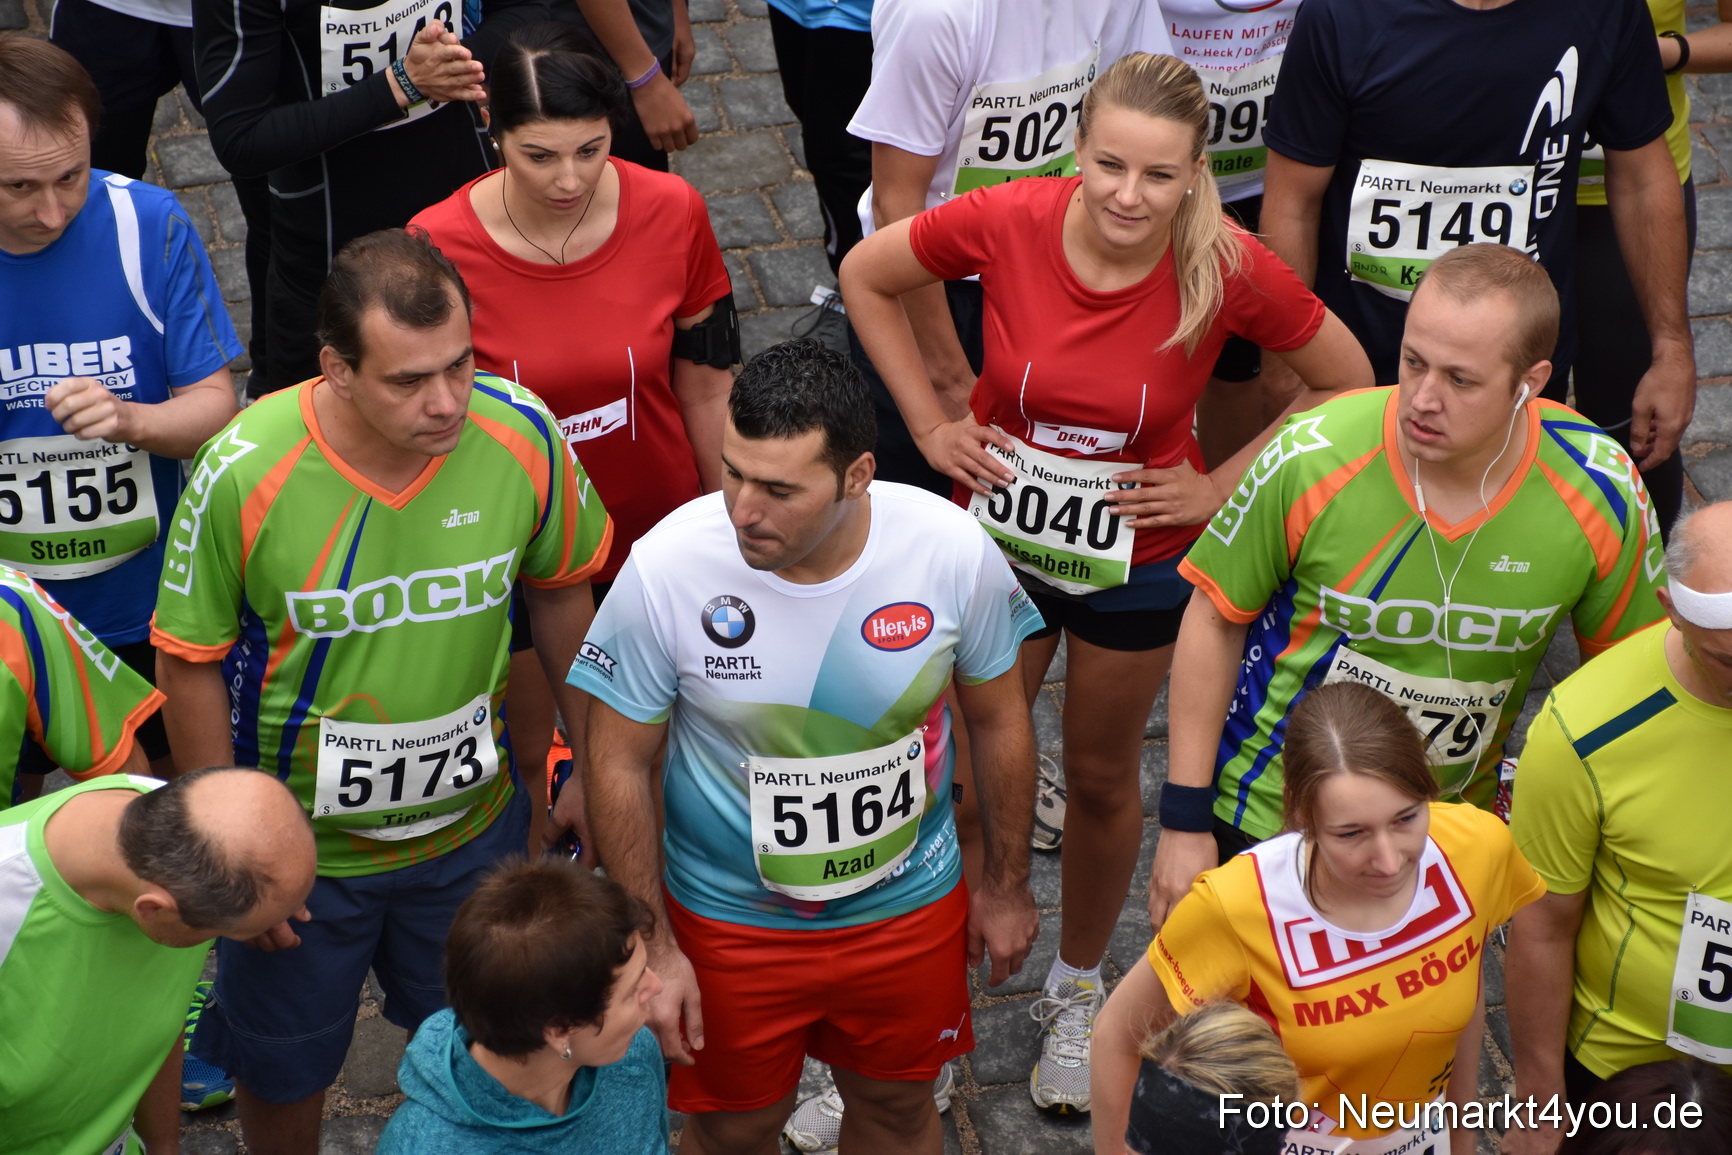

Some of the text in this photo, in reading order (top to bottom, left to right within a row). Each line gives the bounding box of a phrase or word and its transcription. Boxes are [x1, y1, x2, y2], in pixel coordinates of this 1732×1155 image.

[326, 22, 382, 35] PARTL
[1172, 23, 1233, 41] LAUFEN
[1241, 26, 1270, 40] MIT
[1184, 46, 1200, 56] Dr.
[1203, 48, 1233, 57] Heck
[972, 75, 1085, 109] PARTL Neumarkt
[1209, 74, 1276, 97] Neumarkt
[1361, 174, 1502, 194] PARTL Neumarkt
[1368, 199, 1513, 251] 5149
[0, 335, 133, 382] UBER
[6, 398, 45, 411] WASTE
[561, 416, 612, 438] DEHN
[1056, 431, 1099, 448] DEHN
[32, 444, 119, 464] Neumarkt
[1031, 464, 1112, 490] Neumarkt
[0, 461, 138, 526] 5155
[987, 477, 1121, 551] 5040
[30, 538, 107, 561] Stefan
[285, 547, 517, 640] BOCK
[705, 596, 750, 614] BMW
[872, 614, 928, 638] Hervis
[1319, 583, 1562, 654] BOCK
[877, 635, 905, 644] SPORTS
[704, 655, 762, 670] PARTL
[705, 669, 763, 681] Neumarkt
[1336, 659, 1484, 708] PARTL Neumarkt
[324, 720, 469, 752] PARTL Neumarkt
[337, 736, 483, 808] 5173
[754, 756, 902, 787] PARTL Neumarkt
[773, 769, 915, 848] 5164
[822, 848, 875, 880] Azad
[1293, 935, 1481, 1028] MAX BÖGL
